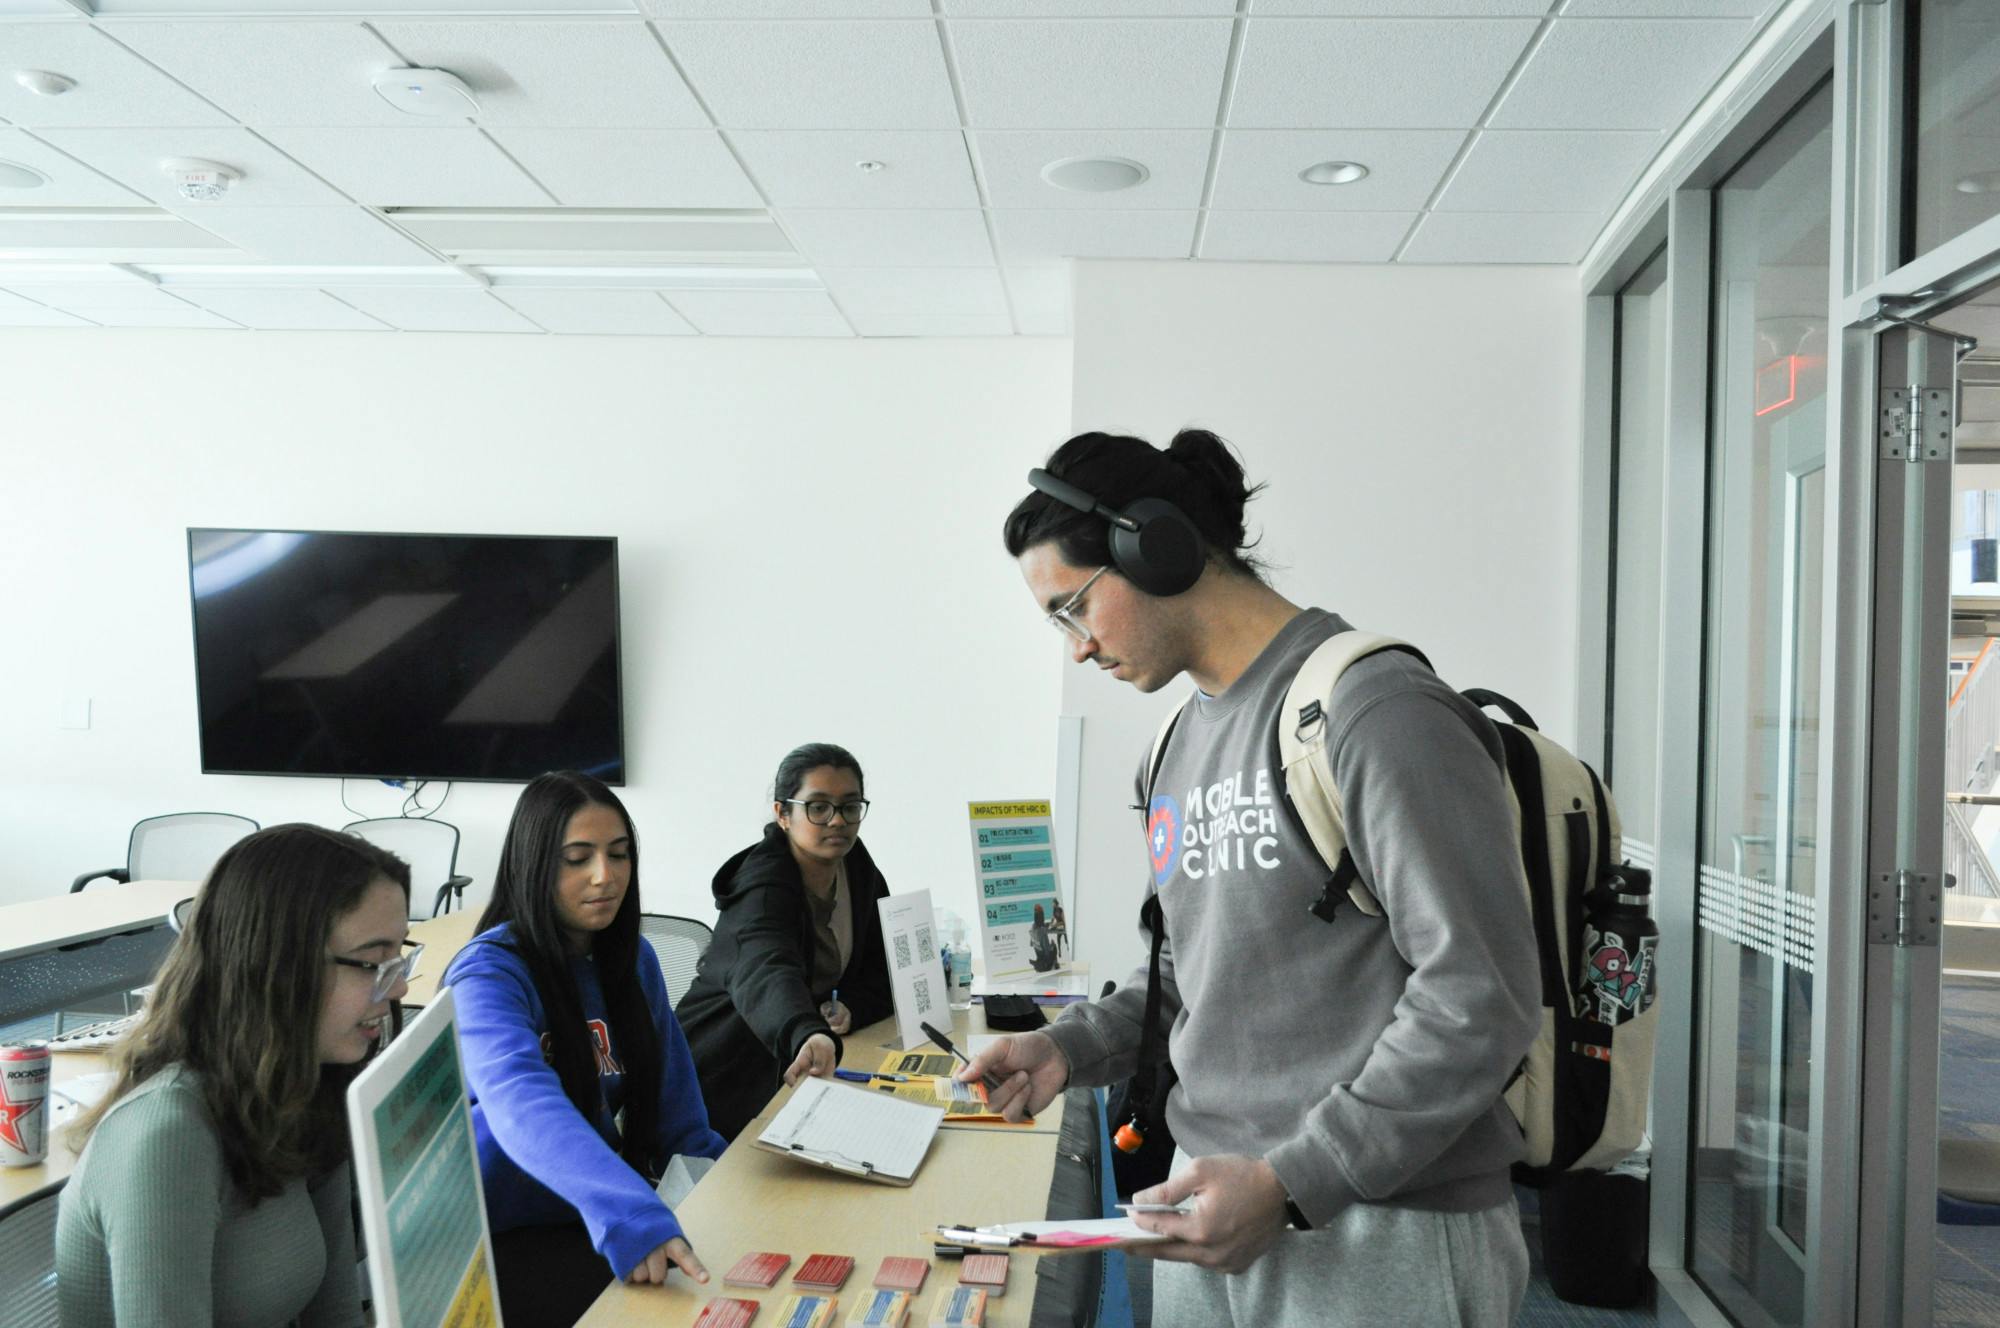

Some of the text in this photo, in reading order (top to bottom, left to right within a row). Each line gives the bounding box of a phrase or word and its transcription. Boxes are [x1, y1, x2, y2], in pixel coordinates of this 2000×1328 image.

[974, 805, 1002, 815] IMPACTS
[1003, 805, 1012, 814] OF
[1014, 805, 1025, 813] THE
[979, 834, 989, 843] 01
[981, 859, 992, 869] 02
[984, 885, 995, 895] 03
[987, 910, 997, 919] 04
